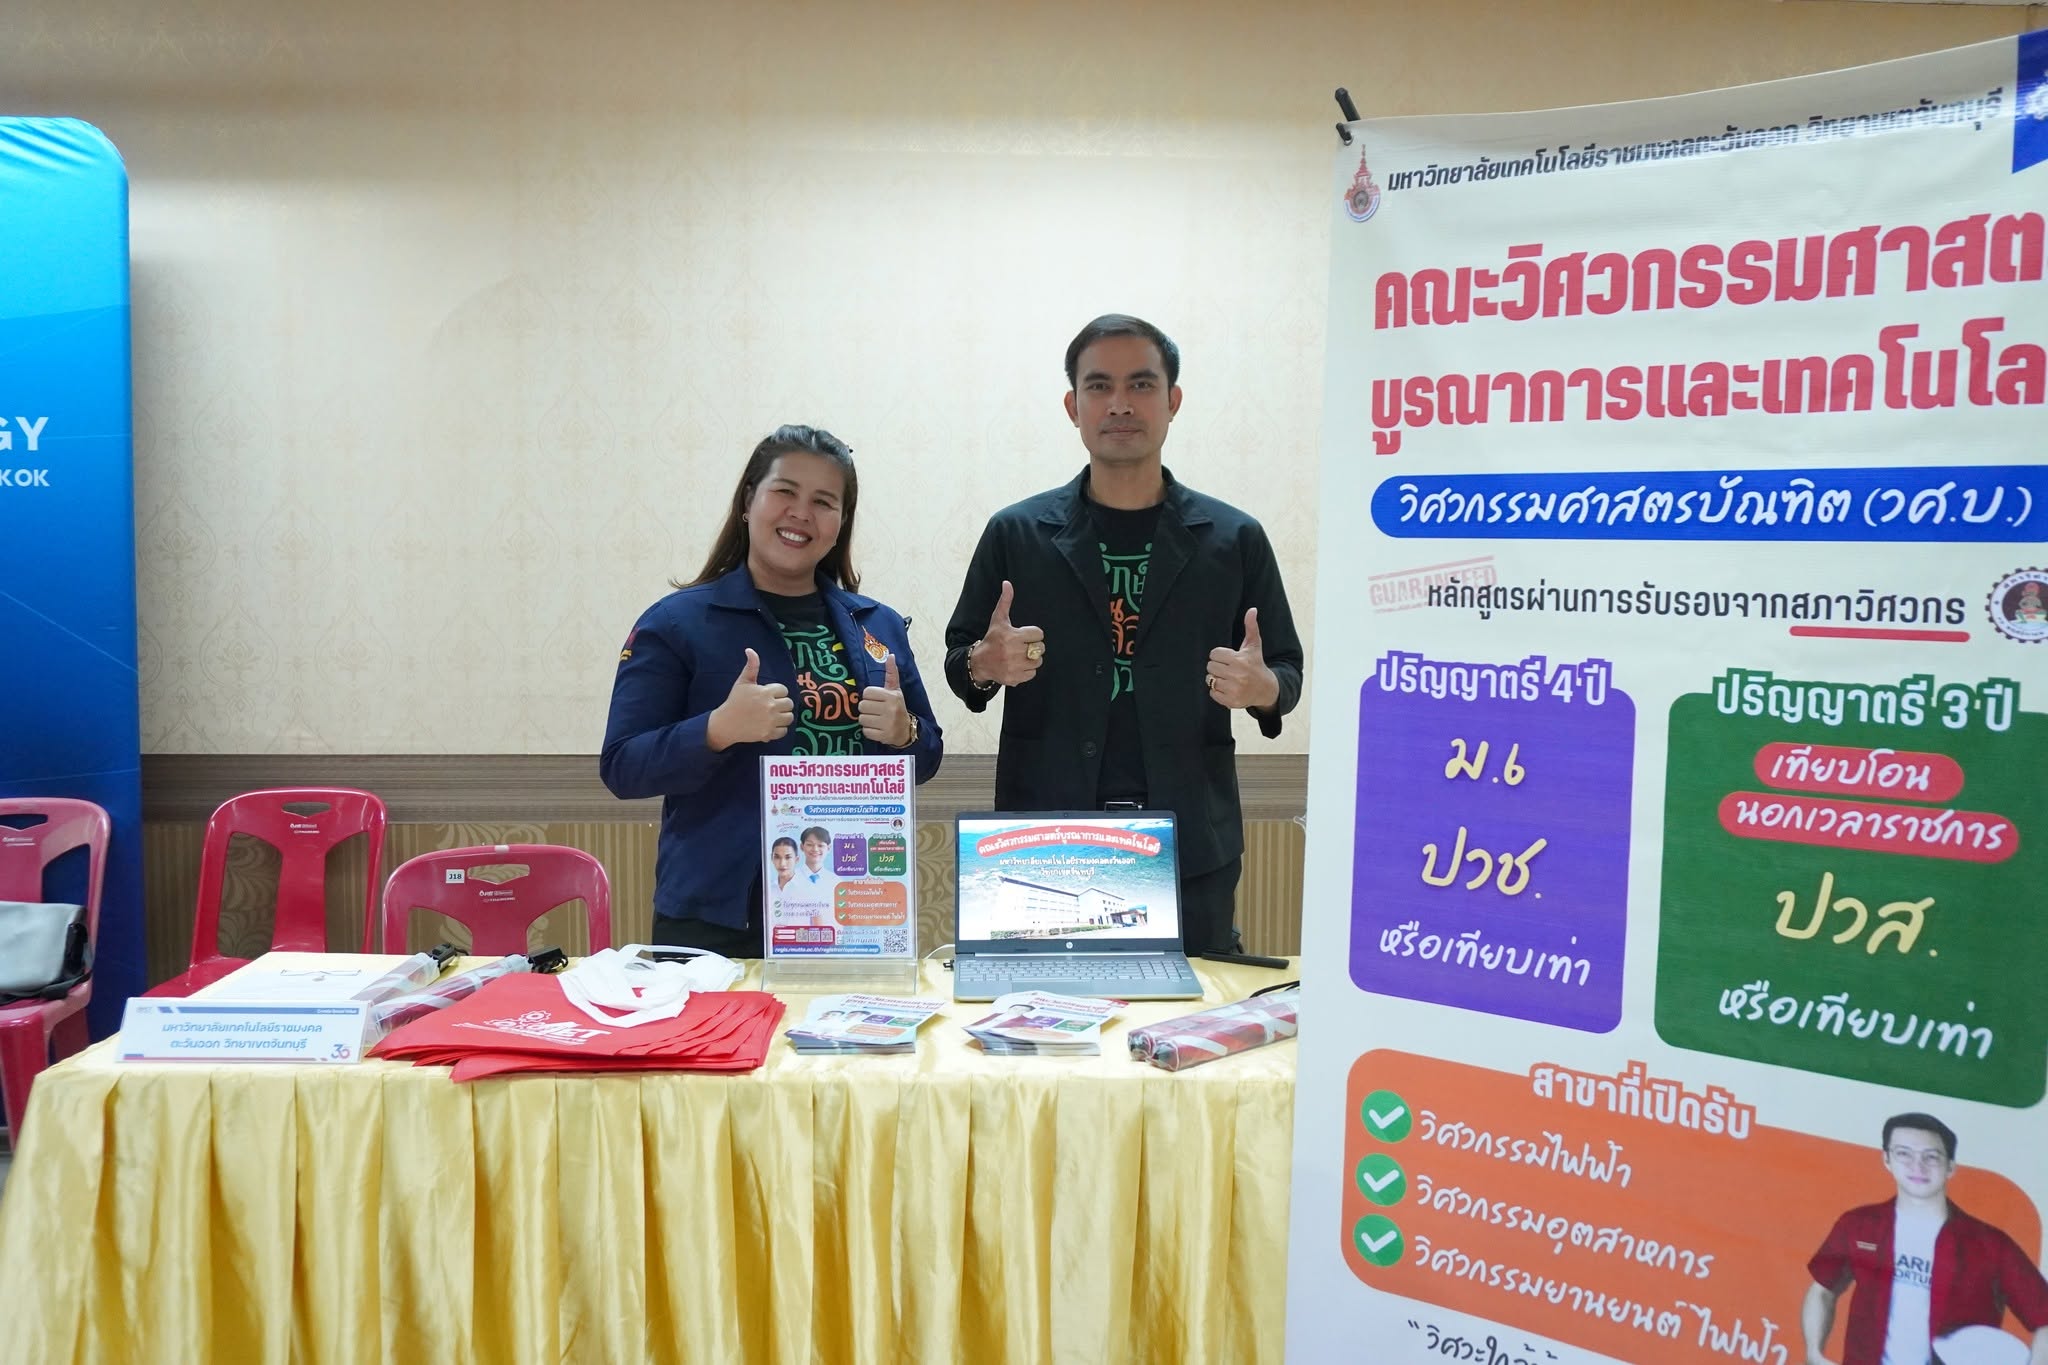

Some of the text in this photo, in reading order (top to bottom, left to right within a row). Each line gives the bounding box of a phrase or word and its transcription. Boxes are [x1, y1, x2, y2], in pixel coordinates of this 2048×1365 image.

[1371, 317, 2046, 455] บูรณาการและเทคโนโล
[1399, 475, 1852, 526] วิศวกรรมศาสตรบัณฑิต
[1428, 576, 1966, 624] หลักสูตรผ่านการรับรองจากสภาวิศวกร
[1379, 656, 1539, 703] ปริญญาตรี
[1585, 661, 1606, 706] ปี
[1717, 673, 1925, 728] ปริญญาตรี
[1985, 681, 2013, 732] ปี
[770, 759, 905, 778] คณะวิศวกรรมศาสตร์
[770, 778, 905, 801] บูรณาการและเทคโนโลยี
[1771, 746, 1930, 791] เทียบโอน
[1736, 796, 2005, 851] นอกเวลาราชการ
[1421, 826, 1547, 899] ปวช.
[1775, 872, 1938, 957] ปวส.
[1380, 919, 1591, 986] หรือเทียบเท่า
[1719, 981, 1994, 1059] หรือเทียบเท่า
[1533, 1065, 1751, 1139] สาขาที่เปิดรับ
[1420, 1110, 1631, 1188] วิศวกรรมไฟฟ้า
[1416, 1175, 1714, 1278] วิศวกรรมอุตสาหการ
